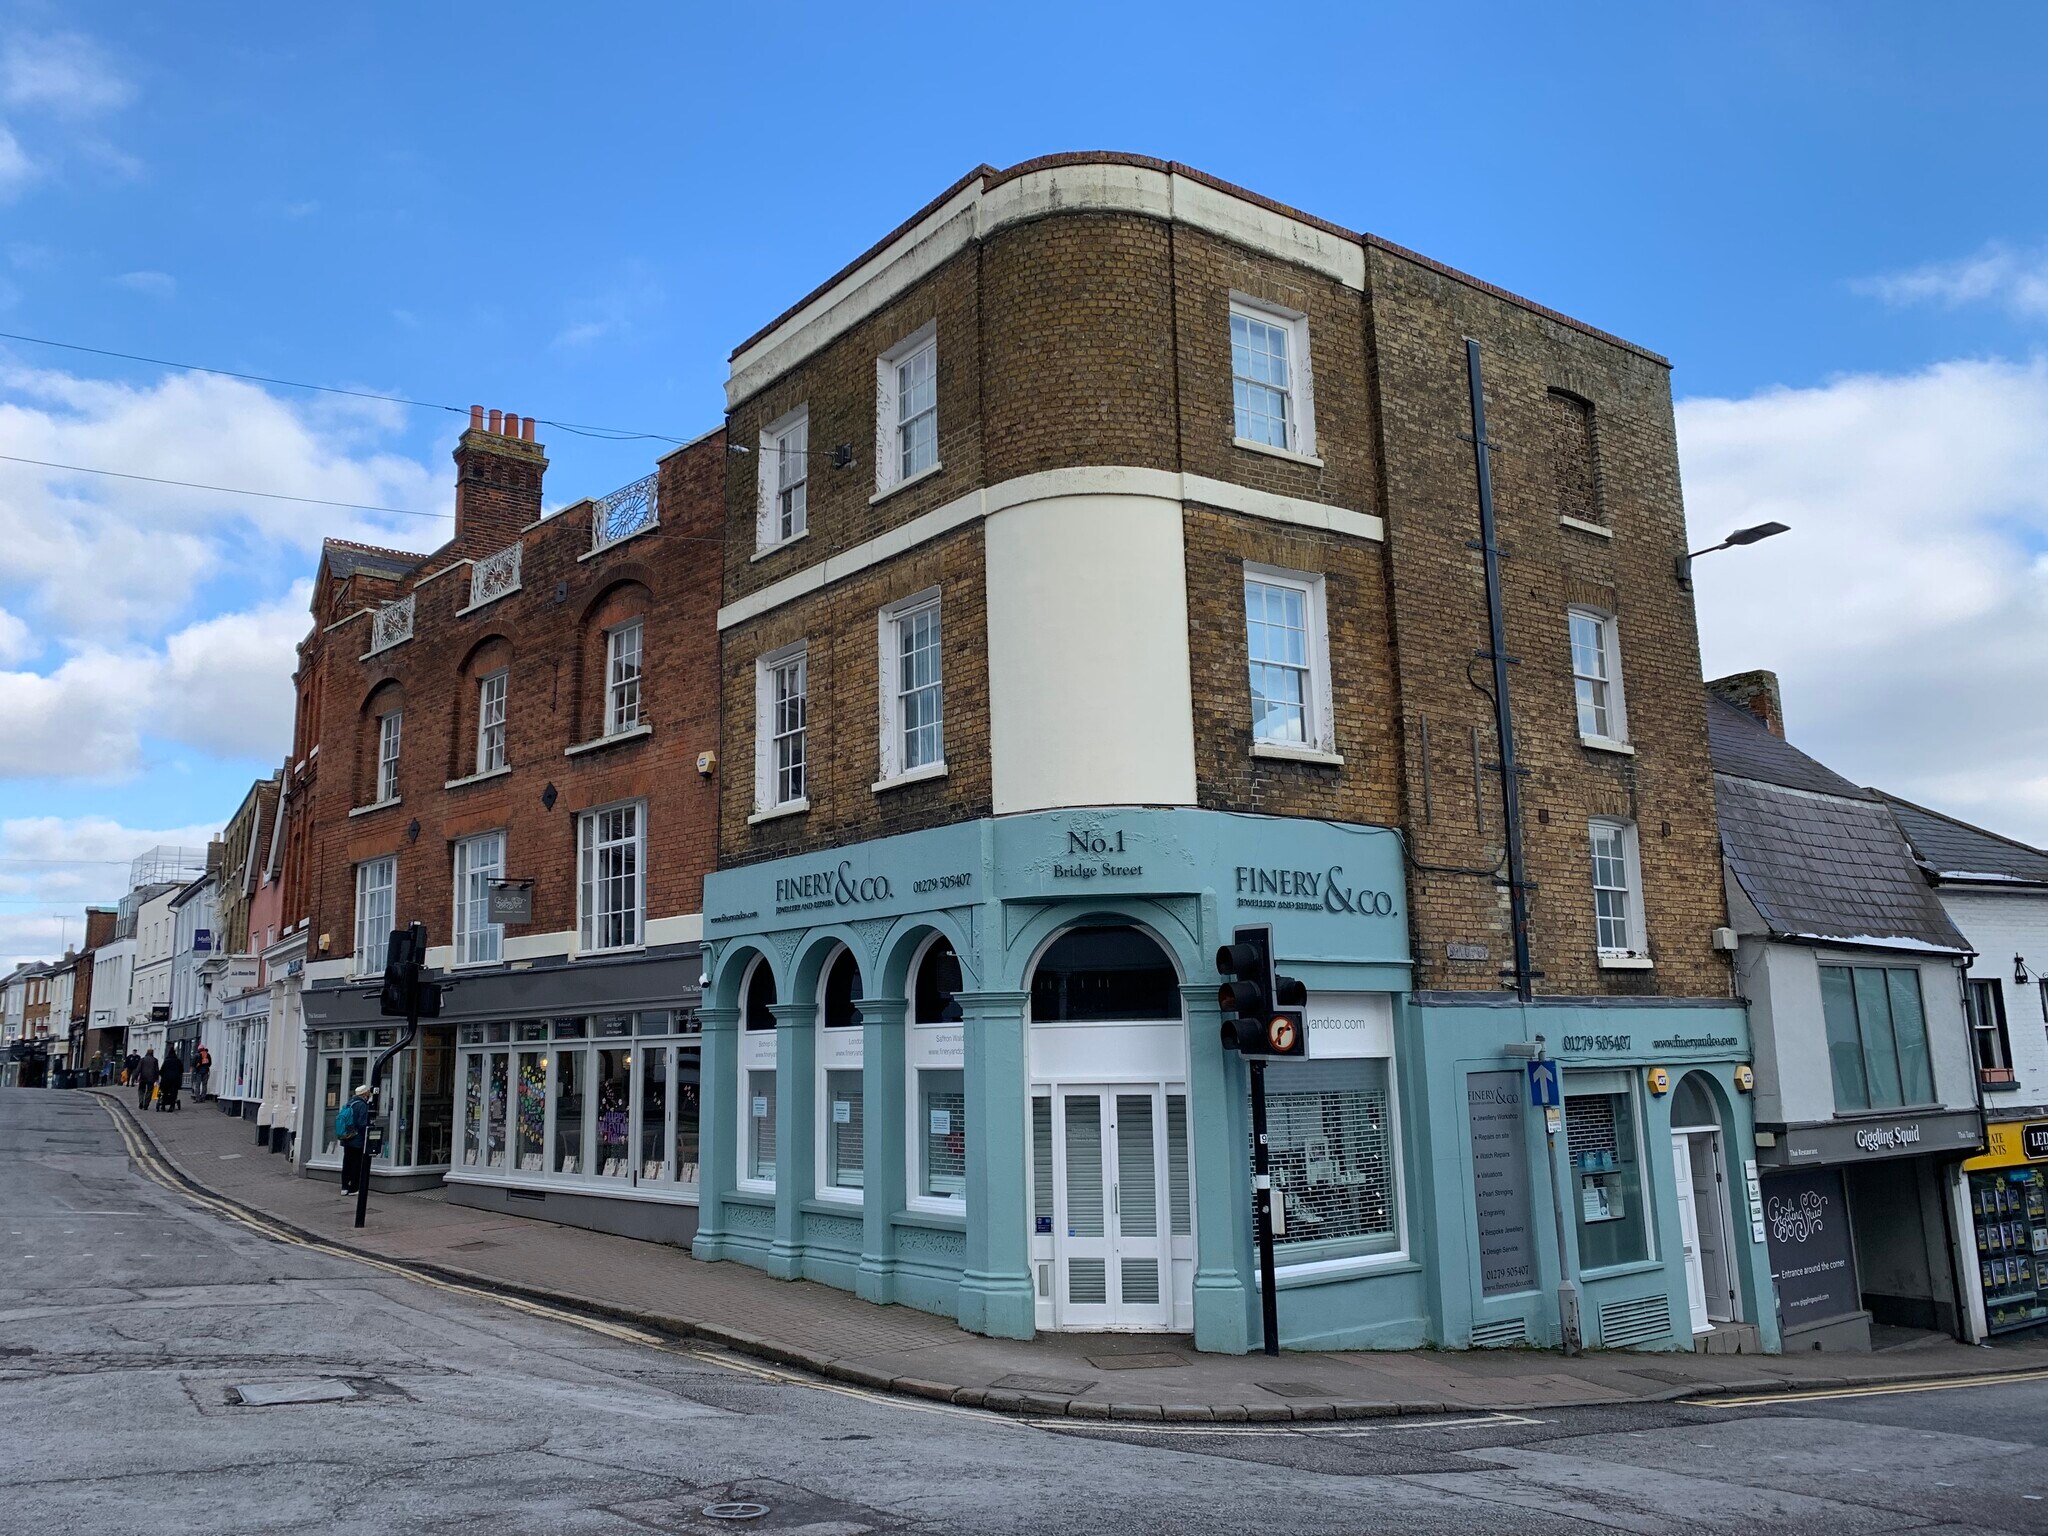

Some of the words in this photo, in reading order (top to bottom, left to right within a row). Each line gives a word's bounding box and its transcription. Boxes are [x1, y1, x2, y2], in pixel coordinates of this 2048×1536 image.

[1067, 829, 1126, 854] No.1
[1053, 864, 1097, 879] Bridge
[1102, 862, 1143, 876] Street
[775, 871, 834, 901] FINERY
[834, 860, 860, 906] &
[912, 878, 938, 893] 01279
[940, 872, 972, 889] 505407
[1236, 866, 1322, 897] FINERY
[1324, 865, 1358, 914] &
[1563, 1035, 1594, 1051] 01279
[1597, 1035, 1631, 1051] 505407
[1468, 1089, 1496, 1101] FINERY
[1477, 1114, 1497, 1122] Jewellery
[1497, 1112, 1519, 1121] Workshop
[1478, 1133, 1495, 1141] Repairs
[1855, 1127, 1895, 1152] Giggling
[1895, 1123, 1920, 1147] Squid
[1990, 1132, 2004, 1144] ATE
[2031, 1131, 2048, 1147] LED
[1494, 1151, 1511, 1159] Repairs
[1480, 1170, 1503, 1179] Valuations
[1494, 1189, 1513, 1197] Stringing
[1483, 1209, 1506, 1218] Engraving
[1485, 1228, 1504, 1237] Bespoke
[1504, 1225, 1524, 1234] Jewellery
[1486, 1248, 1501, 1256] Design
[1502, 1245, 1519, 1253] Service
[1486, 1268, 1506, 1280] 01279
[1506, 1265, 1529, 1278] 505407
[1781, 1267, 1804, 1279] Entrance
[1804, 1263, 1821, 1275] around
[1821, 1261, 1830, 1271] the
[1829, 1259, 1845, 1269] corner
